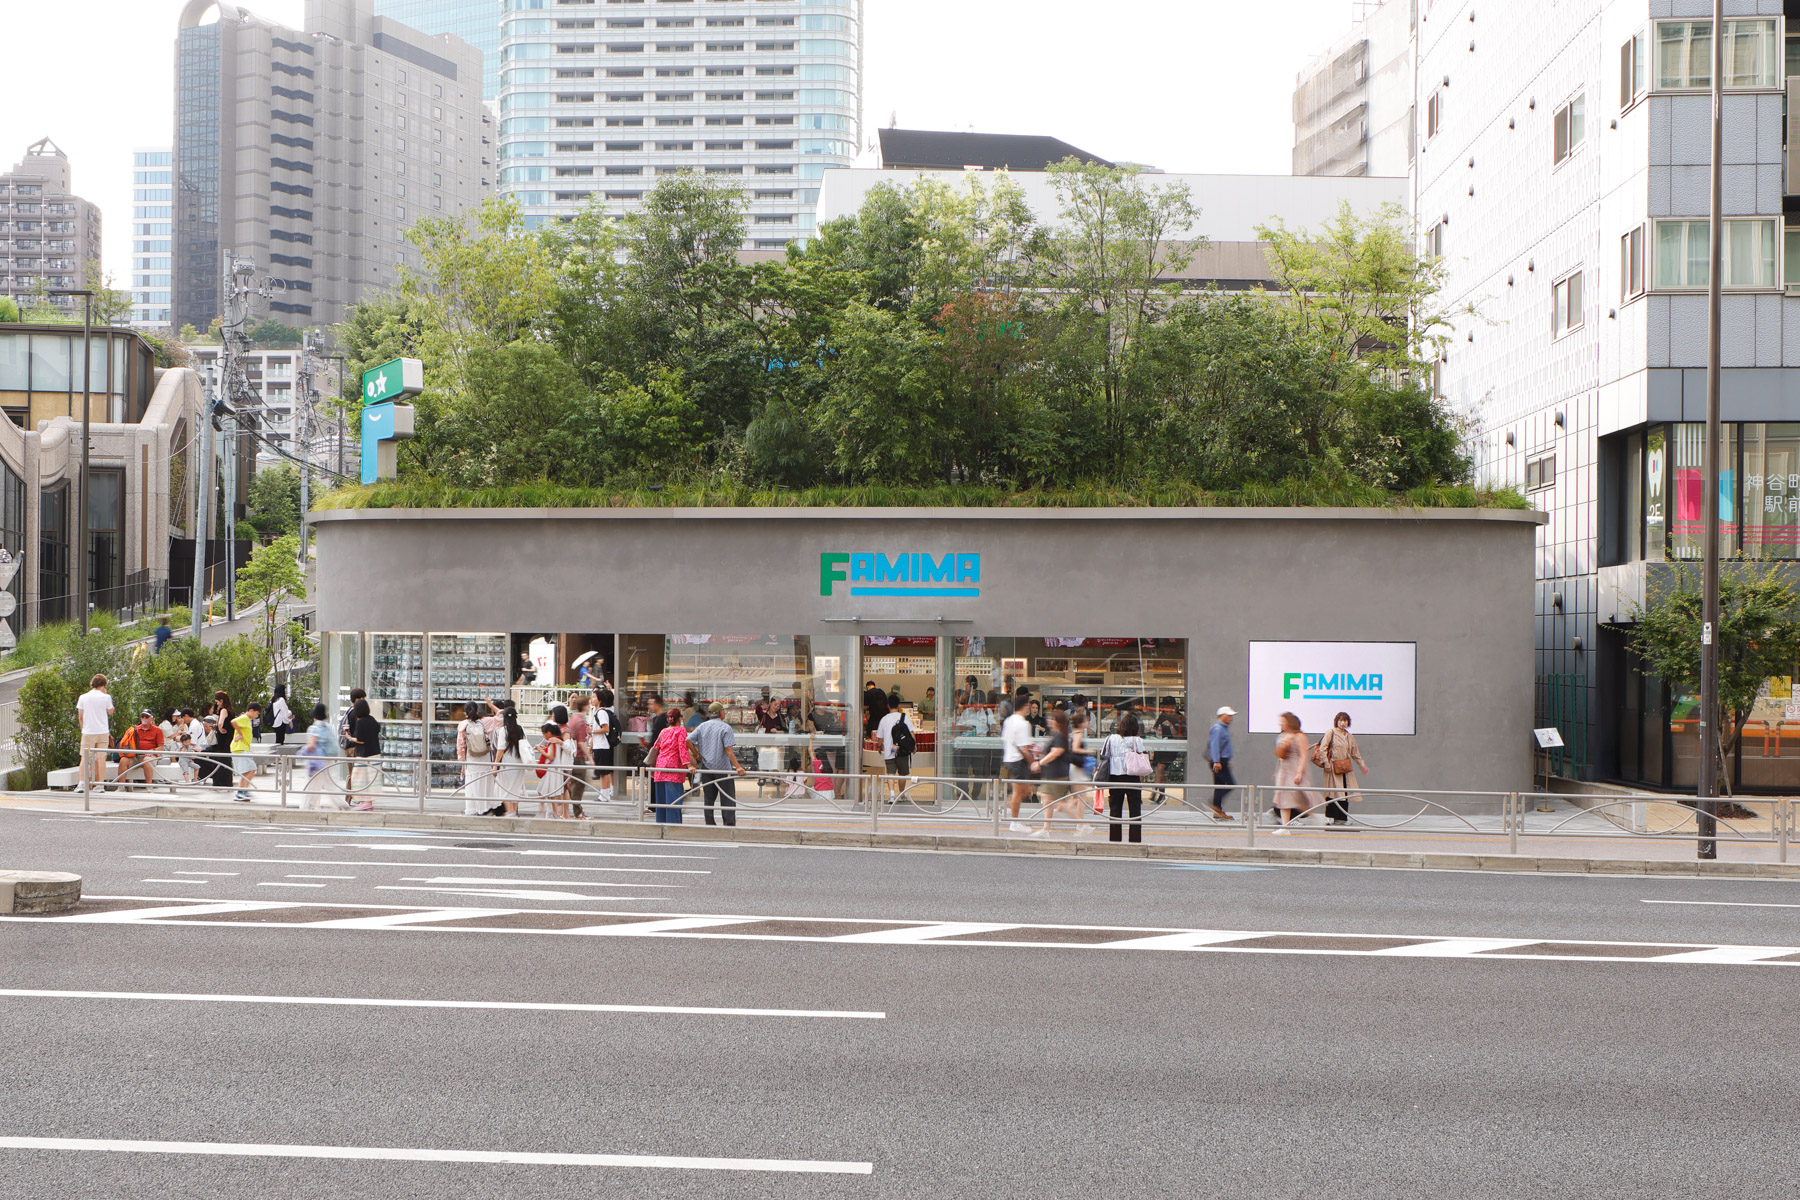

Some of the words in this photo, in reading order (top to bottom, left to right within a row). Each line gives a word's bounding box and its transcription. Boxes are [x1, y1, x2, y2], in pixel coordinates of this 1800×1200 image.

[1649, 503, 1662, 525] 2F
[820, 552, 980, 597] FAMIMA
[1283, 672, 1383, 700] FAMIMA
